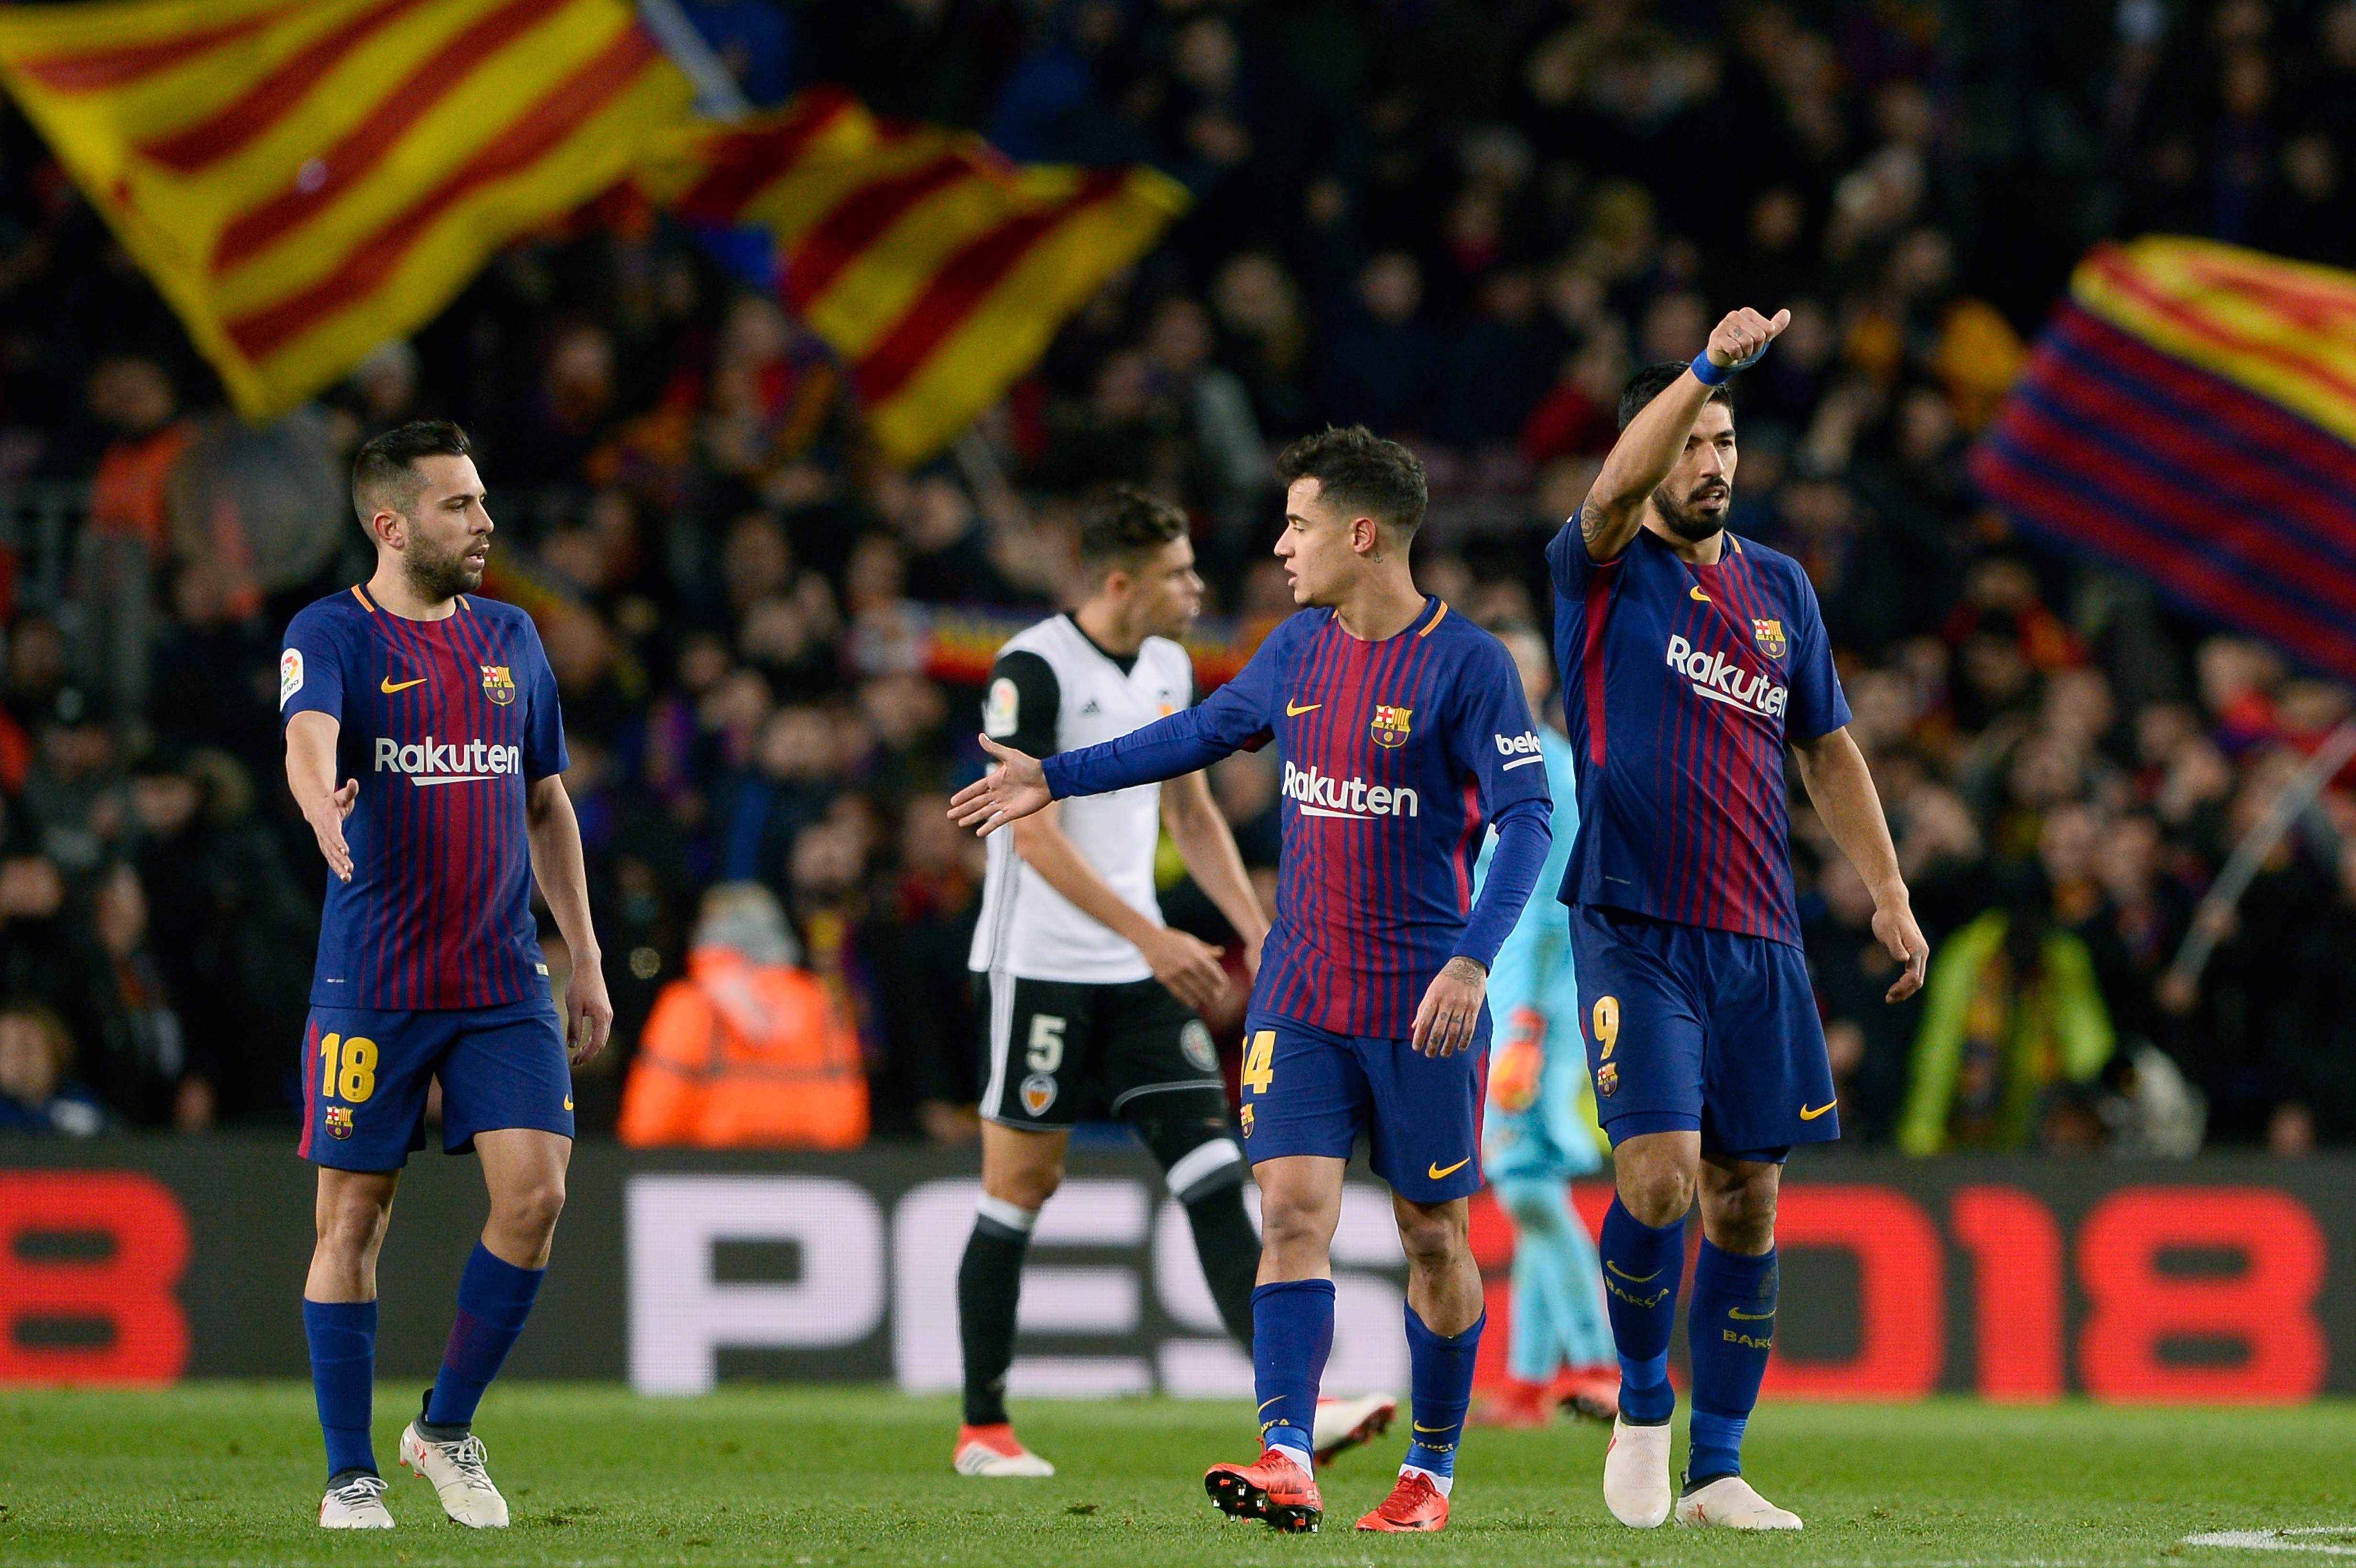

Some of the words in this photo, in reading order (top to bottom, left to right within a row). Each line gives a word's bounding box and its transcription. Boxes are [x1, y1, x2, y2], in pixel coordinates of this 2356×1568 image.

[1667, 634, 1788, 720] Rakuten
[374, 736, 519, 774] Rakuten
[1282, 760, 1418, 817] Rakuten
[1026, 1013, 1067, 1074] 5
[1592, 995, 1619, 1061] 9
[320, 1032, 379, 1103] 18
[0, 1170, 190, 1391] 8
